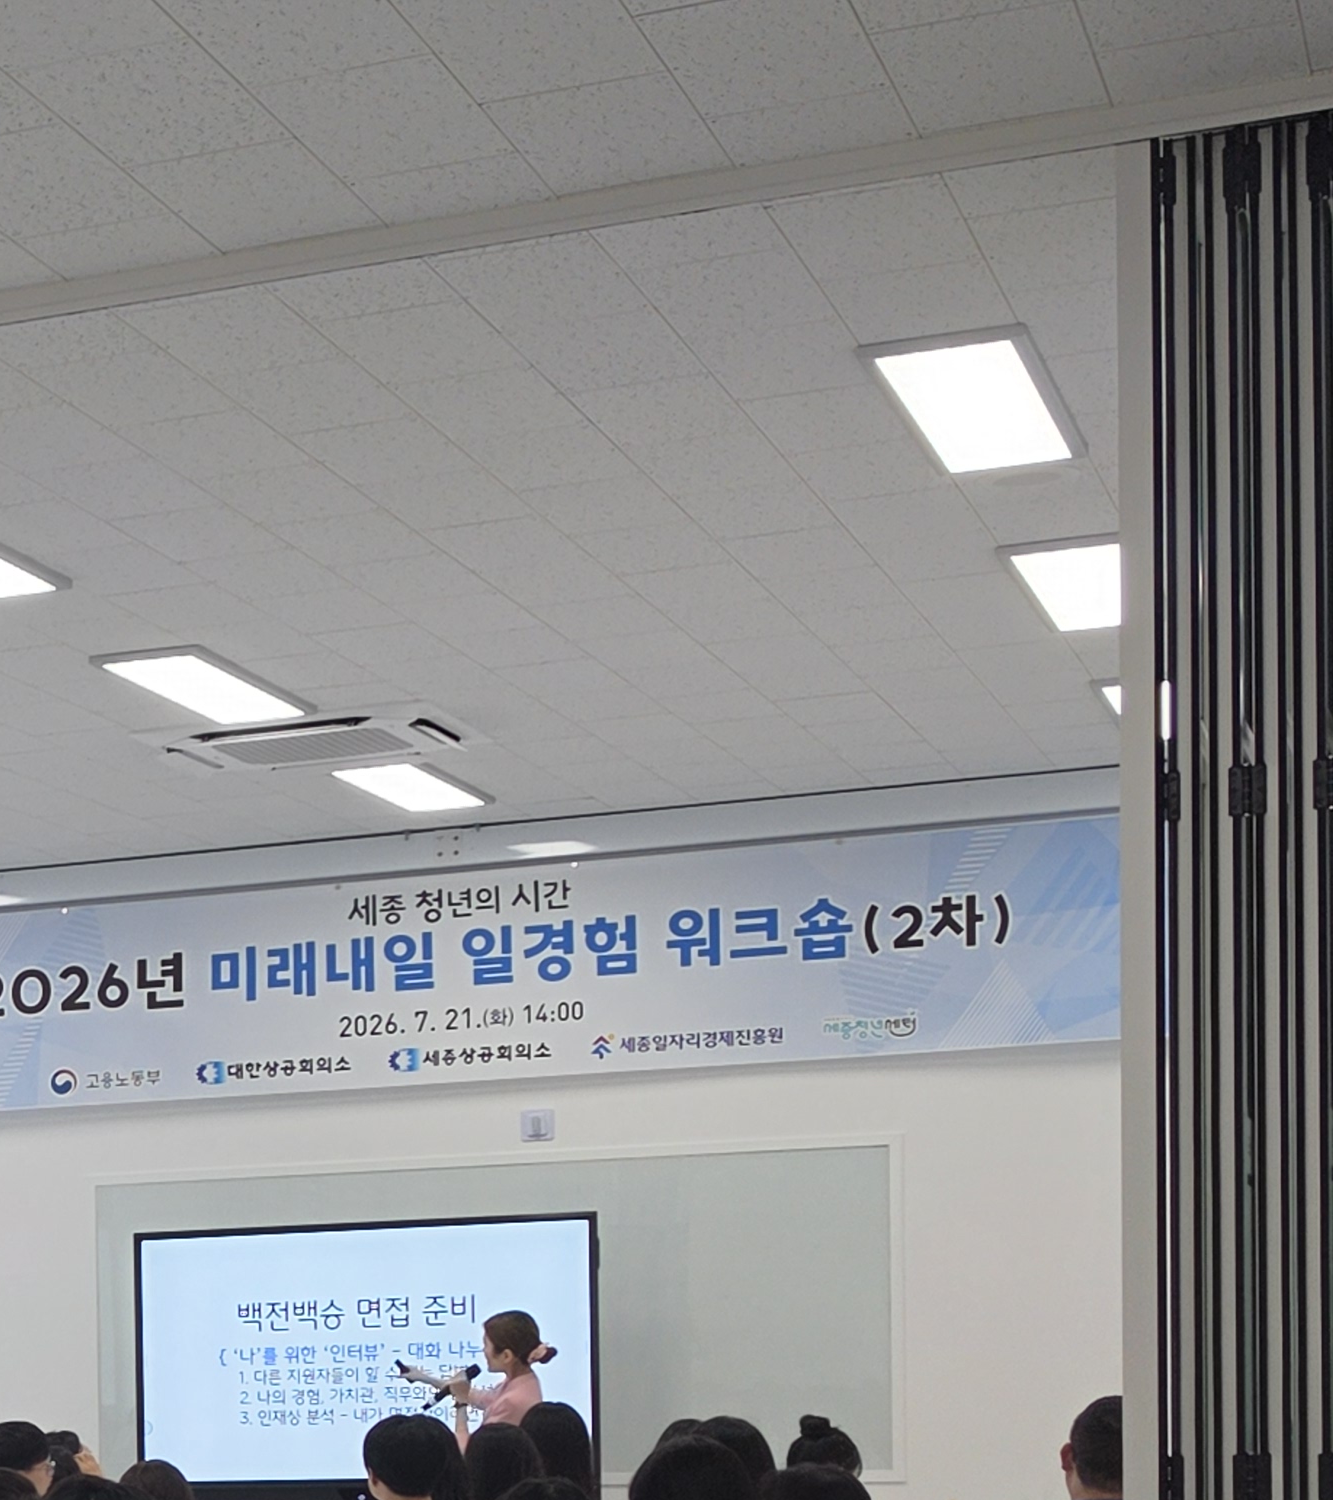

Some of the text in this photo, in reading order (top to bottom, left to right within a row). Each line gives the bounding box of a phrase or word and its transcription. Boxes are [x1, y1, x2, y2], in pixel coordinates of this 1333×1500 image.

[347, 880, 572, 927] 세종 청년의 시간
[210, 930, 436, 1002] 미래내일
[461, 914, 639, 986] 일경험
[665, 894, 1011, 967] 워크숍(2차)
[339, 1001, 584, 1038] 2026. 7. 21.(화) 14:00
[620, 1027, 784, 1054] 세종일자리경제진흥원
[423, 1042, 552, 1067] 세종상공회의소
[86, 1070, 161, 1090] 고용노동부
[227, 1056, 352, 1081] 대한상공회의소
[237, 1294, 476, 1332] 백전백승 면접 준비
[284, 1346, 317, 1364] 위한
[408, 1342, 441, 1360] 대화
[449, 1340, 484, 1359] 나누
[238, 1371, 249, 1385] 1.
[254, 1369, 282, 1386] 다른
[287, 1367, 359, 1385] 지원자들이
[239, 1391, 252, 1405] 2.
[257, 1389, 286, 1405] 나의
[292, 1388, 324, 1406] 경험,
[330, 1387, 378, 1404] 가치관,
[239, 1411, 253, 1425] 3.
[257, 1409, 302, 1427] 인재상
[307, 1408, 334, 1426] 분석
[353, 1407, 383, 1424] 내가
